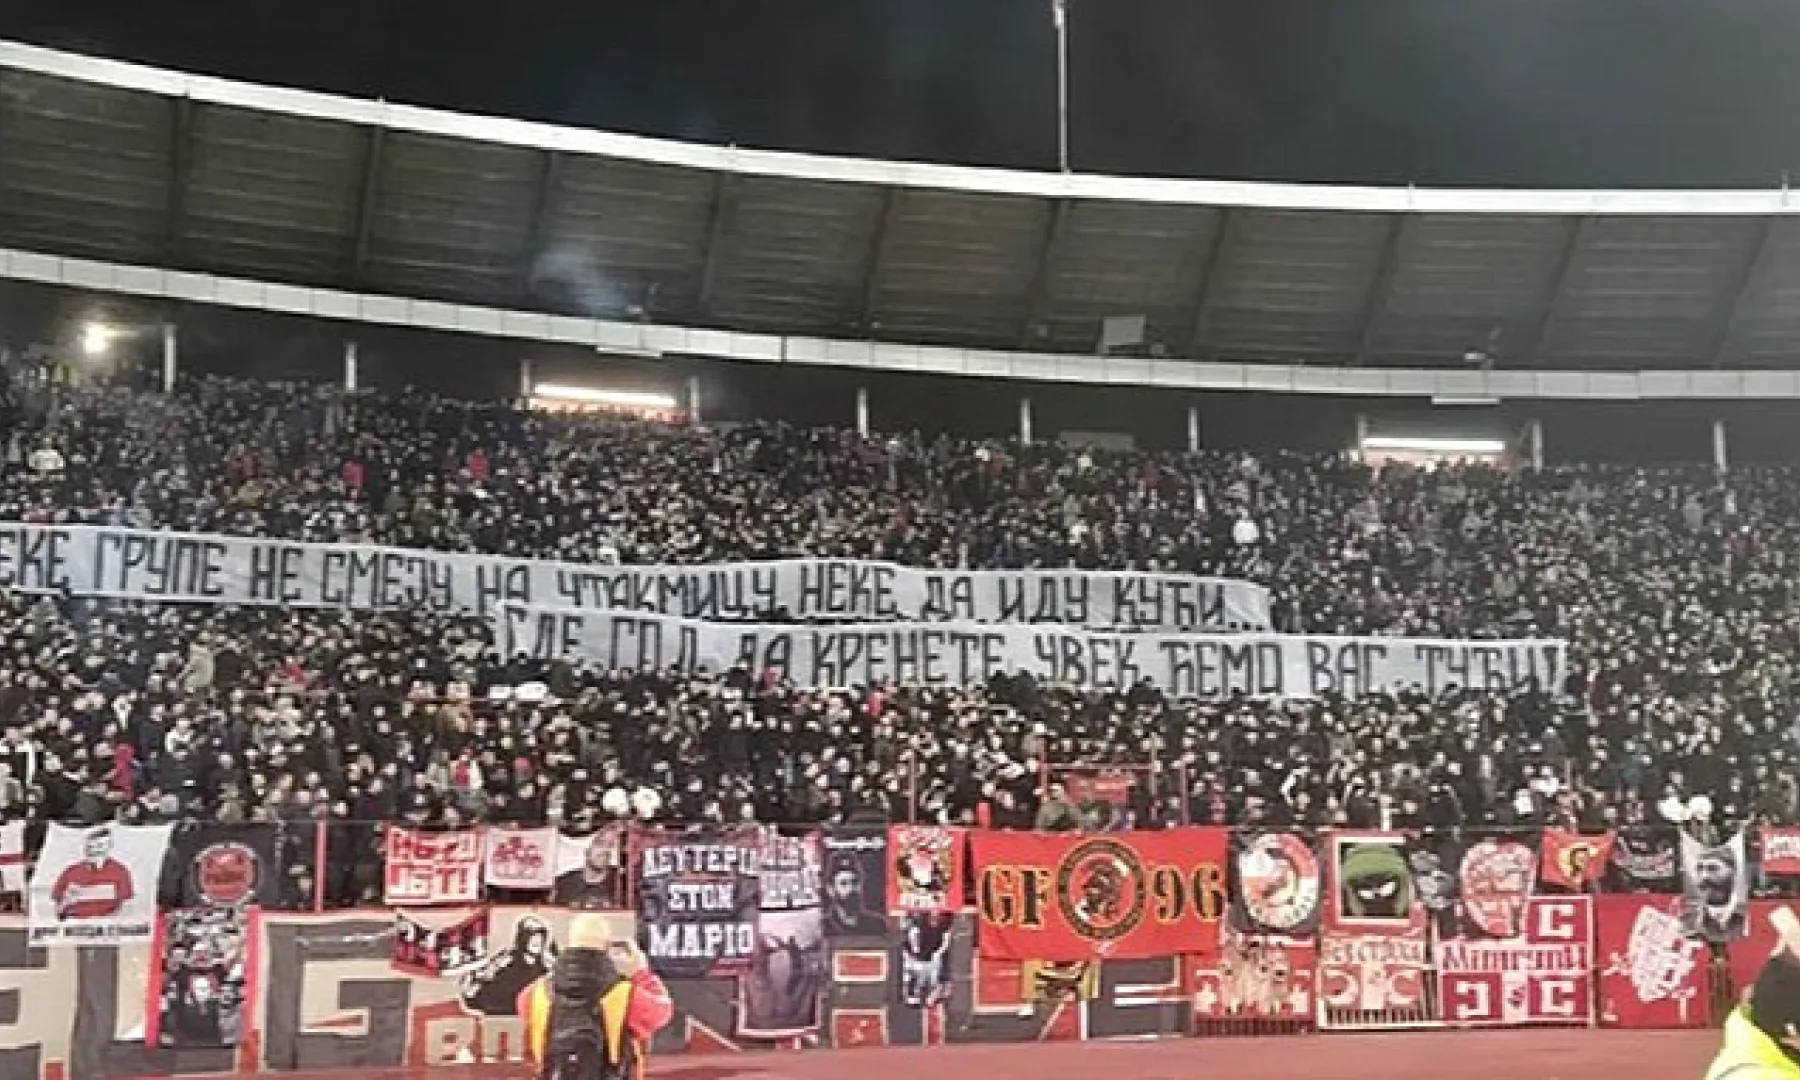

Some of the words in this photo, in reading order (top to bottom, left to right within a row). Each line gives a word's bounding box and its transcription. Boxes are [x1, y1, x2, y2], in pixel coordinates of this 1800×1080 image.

[94, 530, 227, 595] ГРУПЕ
[250, 545, 304, 600] НЕ
[475, 564, 531, 611] НА
[800, 562, 897, 615] НЕКЕ
[921, 576, 974, 621] ДА
[998, 576, 1088, 623] ИДУ
[981, 865, 1051, 929] GF
[1152, 864, 1226, 922] 96
